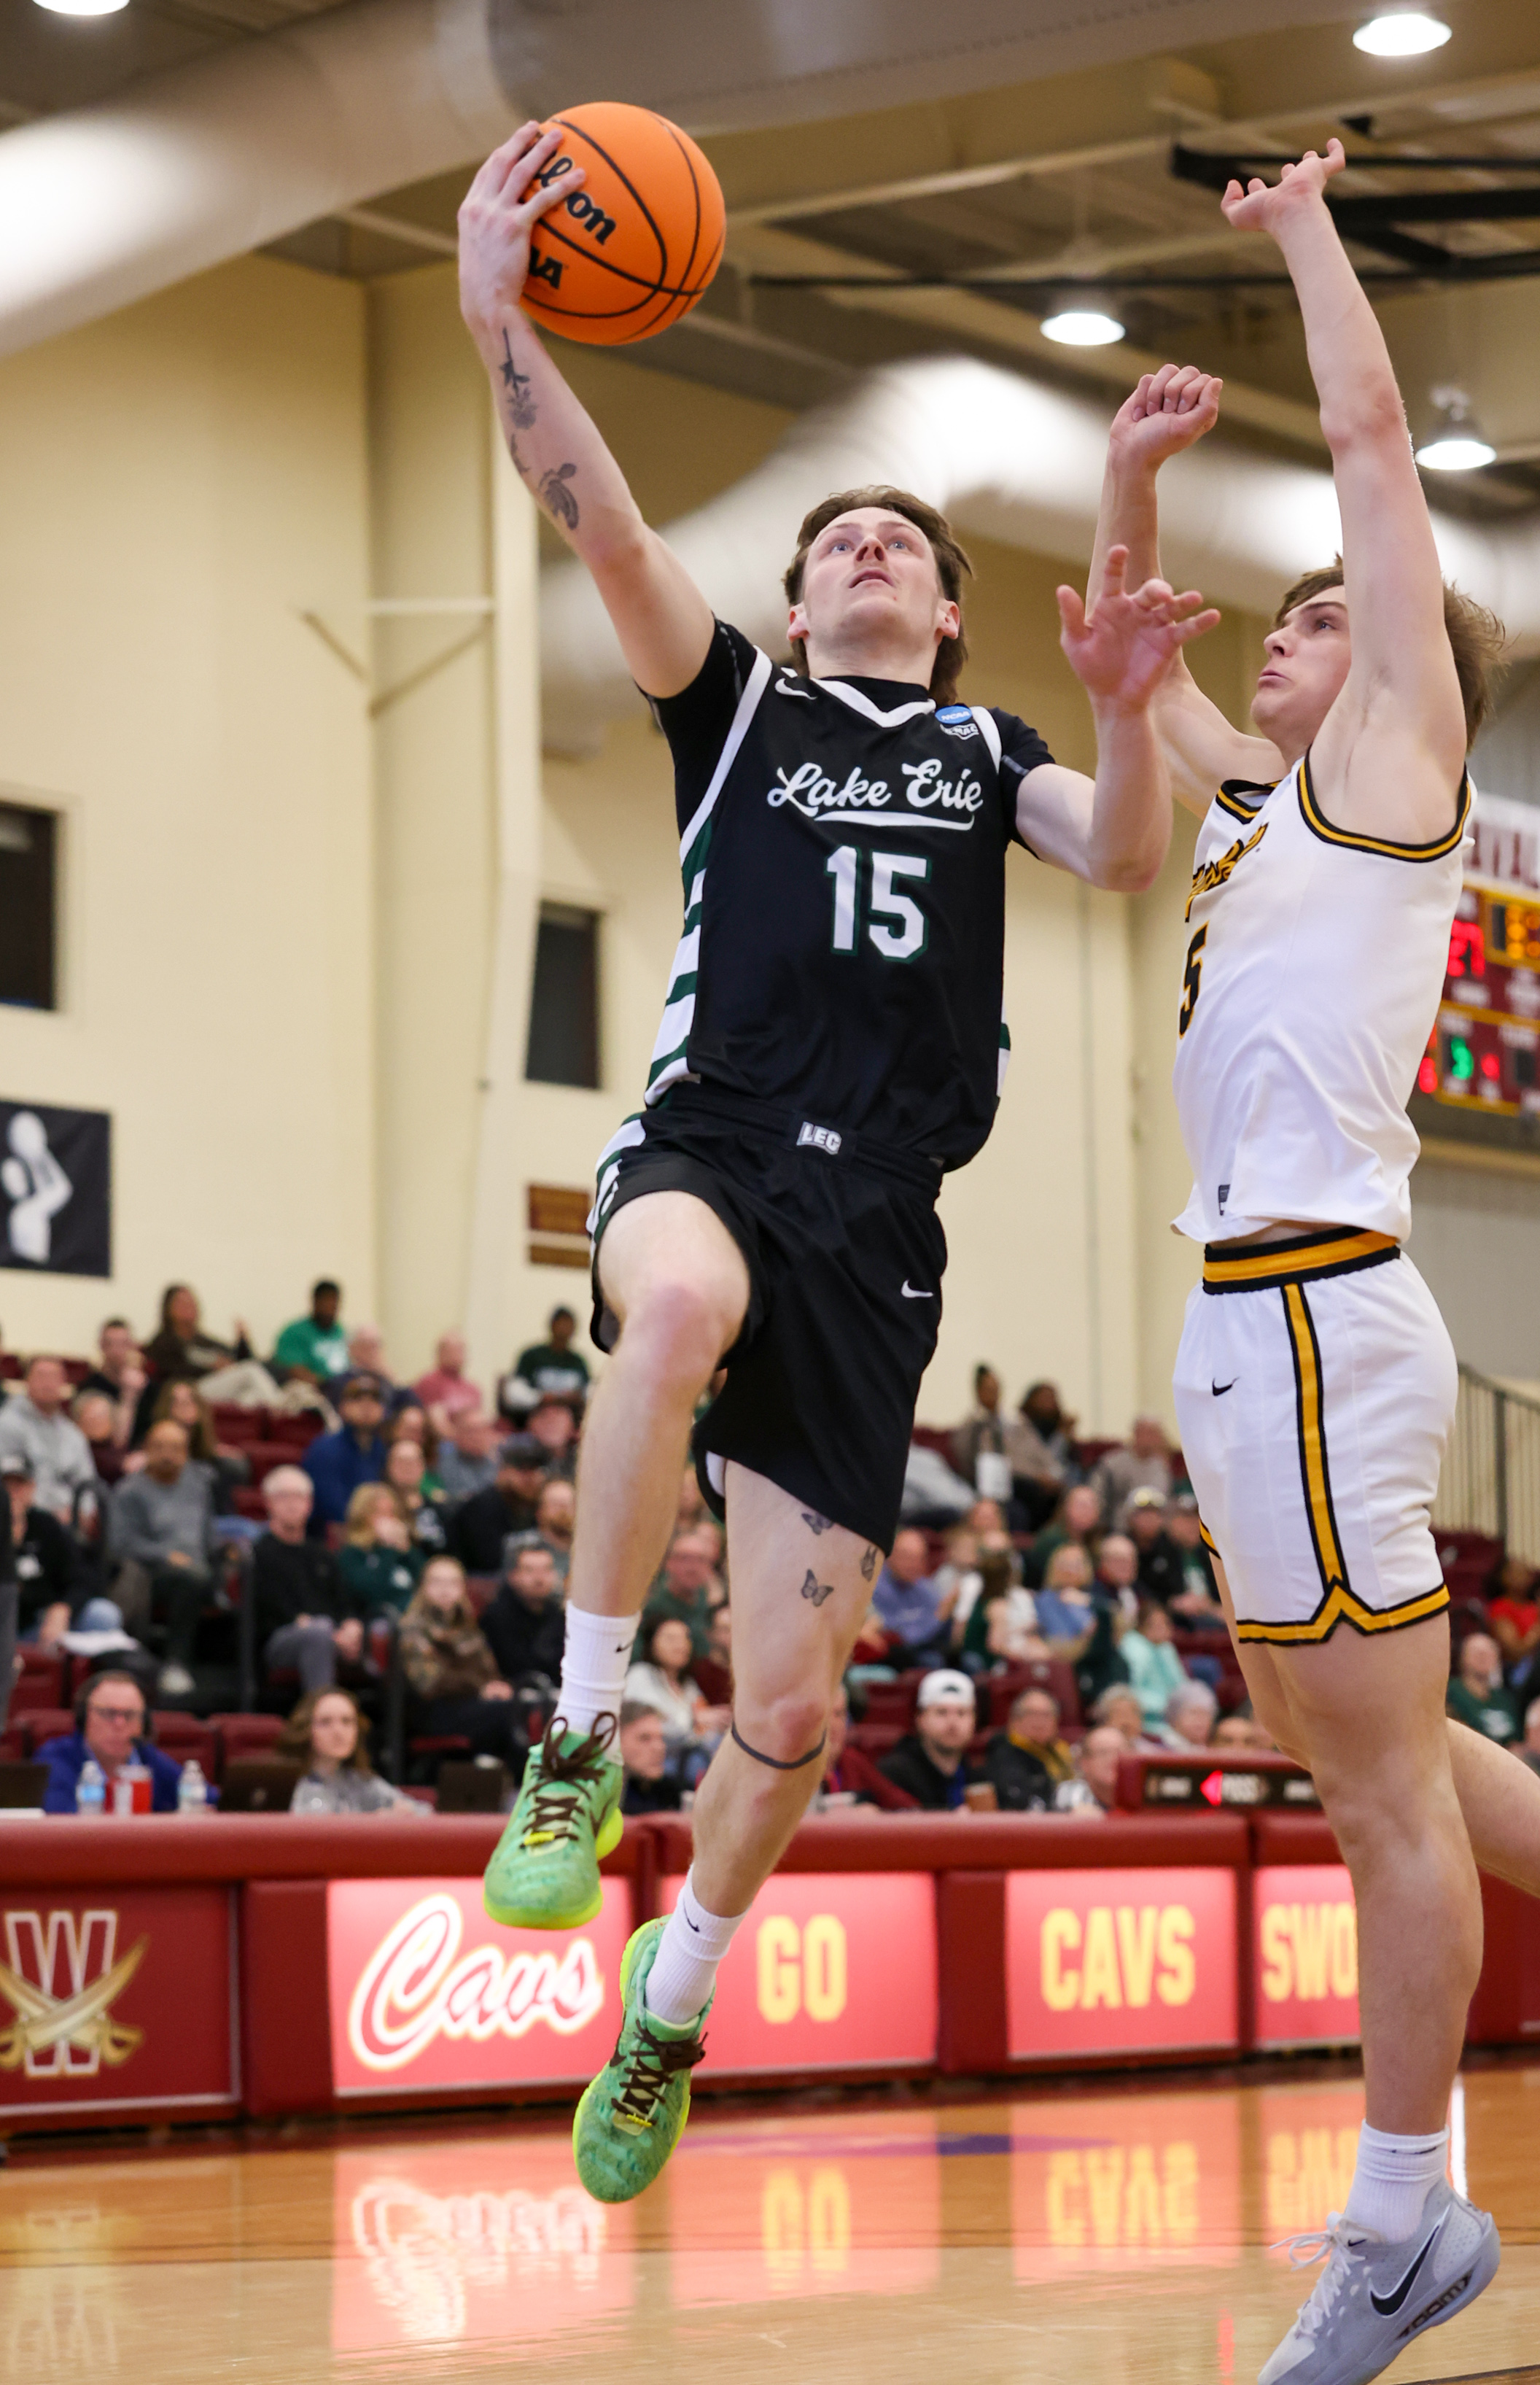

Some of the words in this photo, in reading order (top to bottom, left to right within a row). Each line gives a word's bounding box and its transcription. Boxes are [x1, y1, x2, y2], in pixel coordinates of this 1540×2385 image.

[526, 150, 617, 246] lon
[941, 710, 971, 721] NCAA
[768, 762, 891, 818] Lake
[902, 759, 984, 812] Erie
[824, 845, 932, 963] 15
[796, 1121, 842, 1155] LEC
[348, 1893, 604, 2072] Cavs
[757, 1914, 847, 2024] GO
[1041, 1905, 1196, 2012] CAVS
